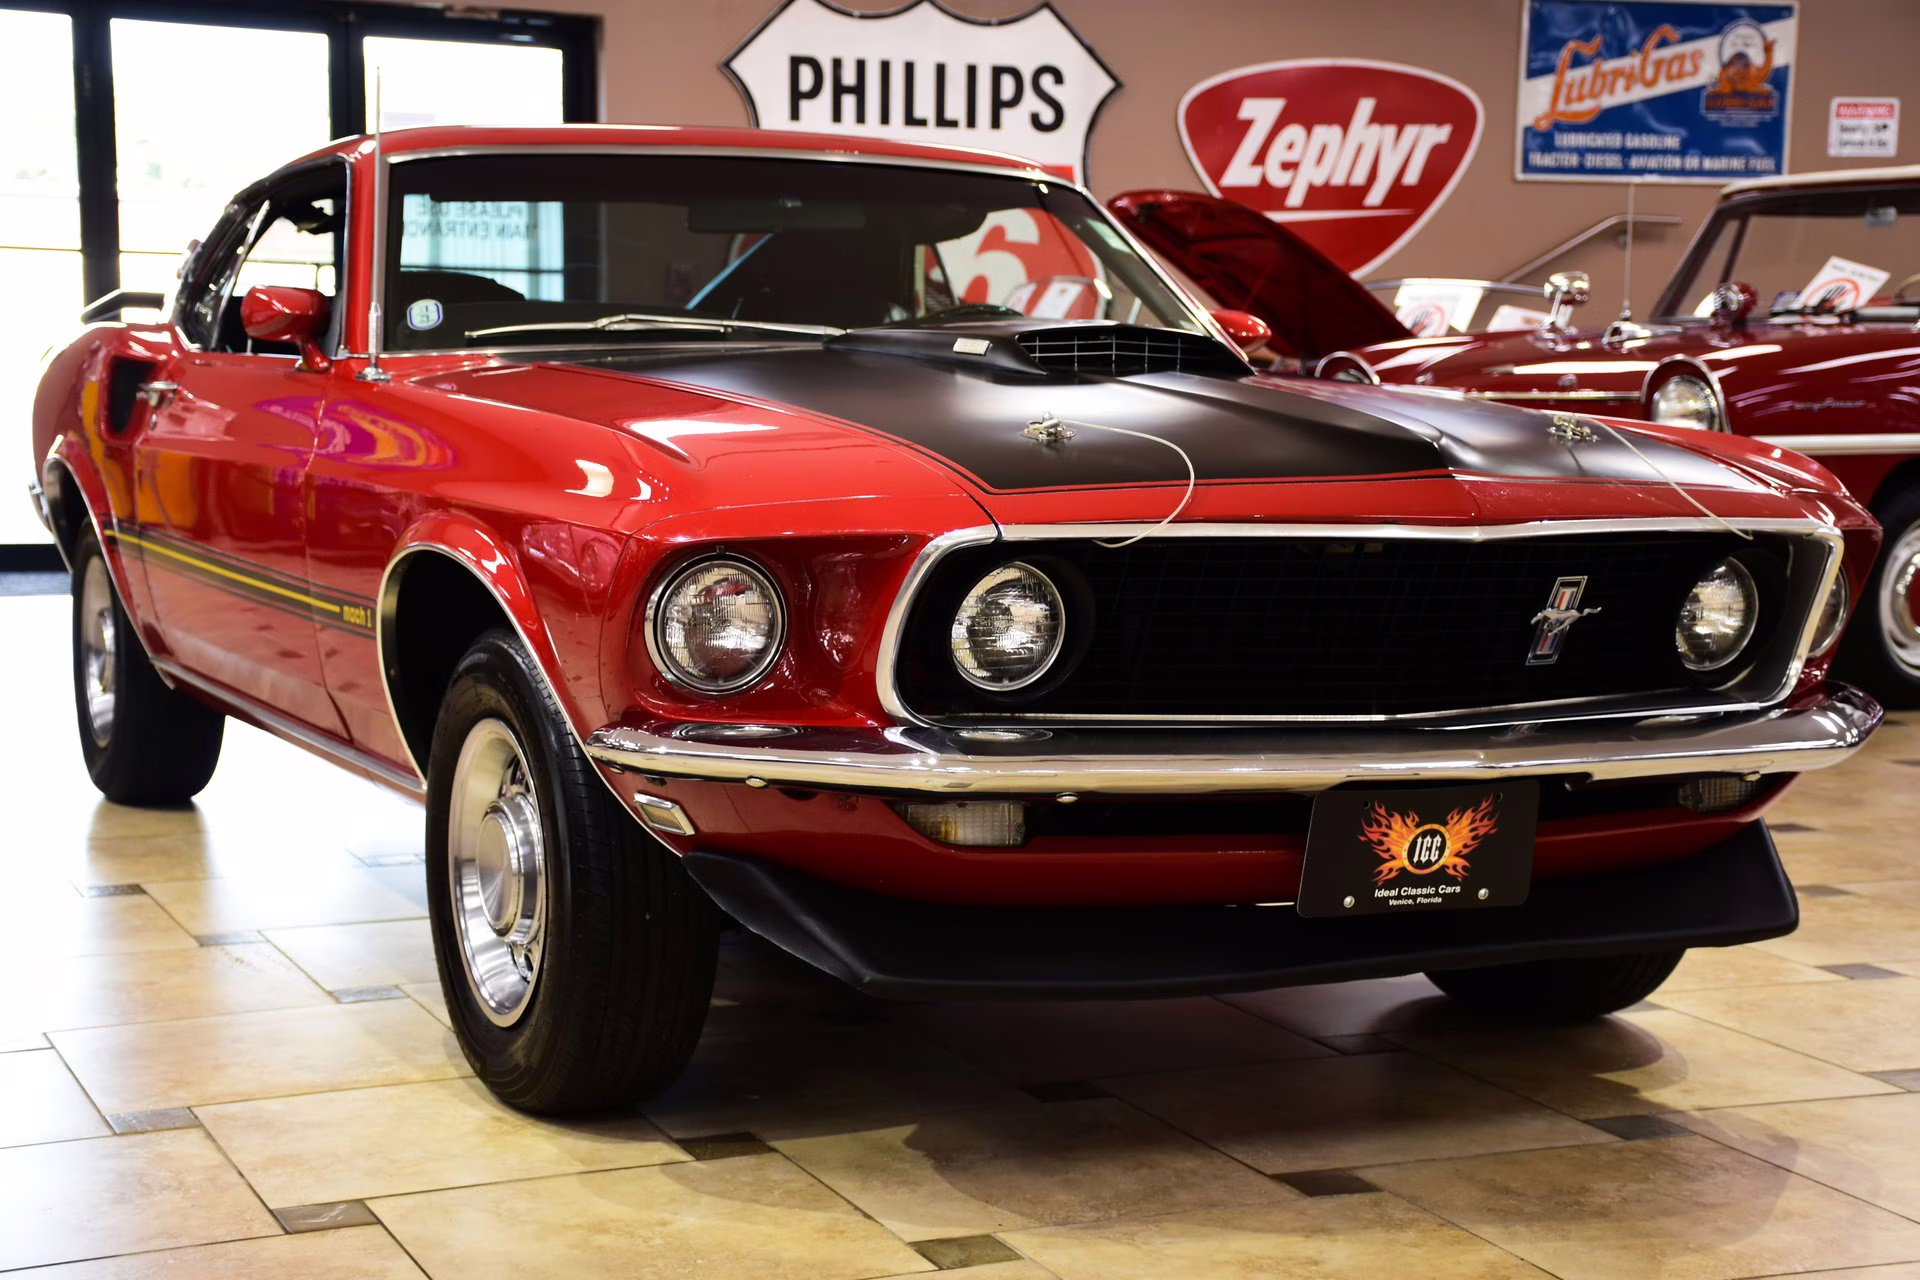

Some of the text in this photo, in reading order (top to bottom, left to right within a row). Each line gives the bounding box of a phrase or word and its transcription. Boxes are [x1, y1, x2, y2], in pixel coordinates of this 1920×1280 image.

[788, 55, 1064, 133] PHILLIPS
[1554, 132, 1681, 149] LUBRICATED GASOLINE
[1219, 97, 1453, 207] Zephyr
[1529, 152, 1776, 171] TRACTOR DIESEL AVIATION OR MARINE FUEL
[343, 605, 372, 628] mach 1
[1374, 884, 1461, 898] Ideal Classic Cars
[1389, 896, 1442, 906] Venice, Florida
